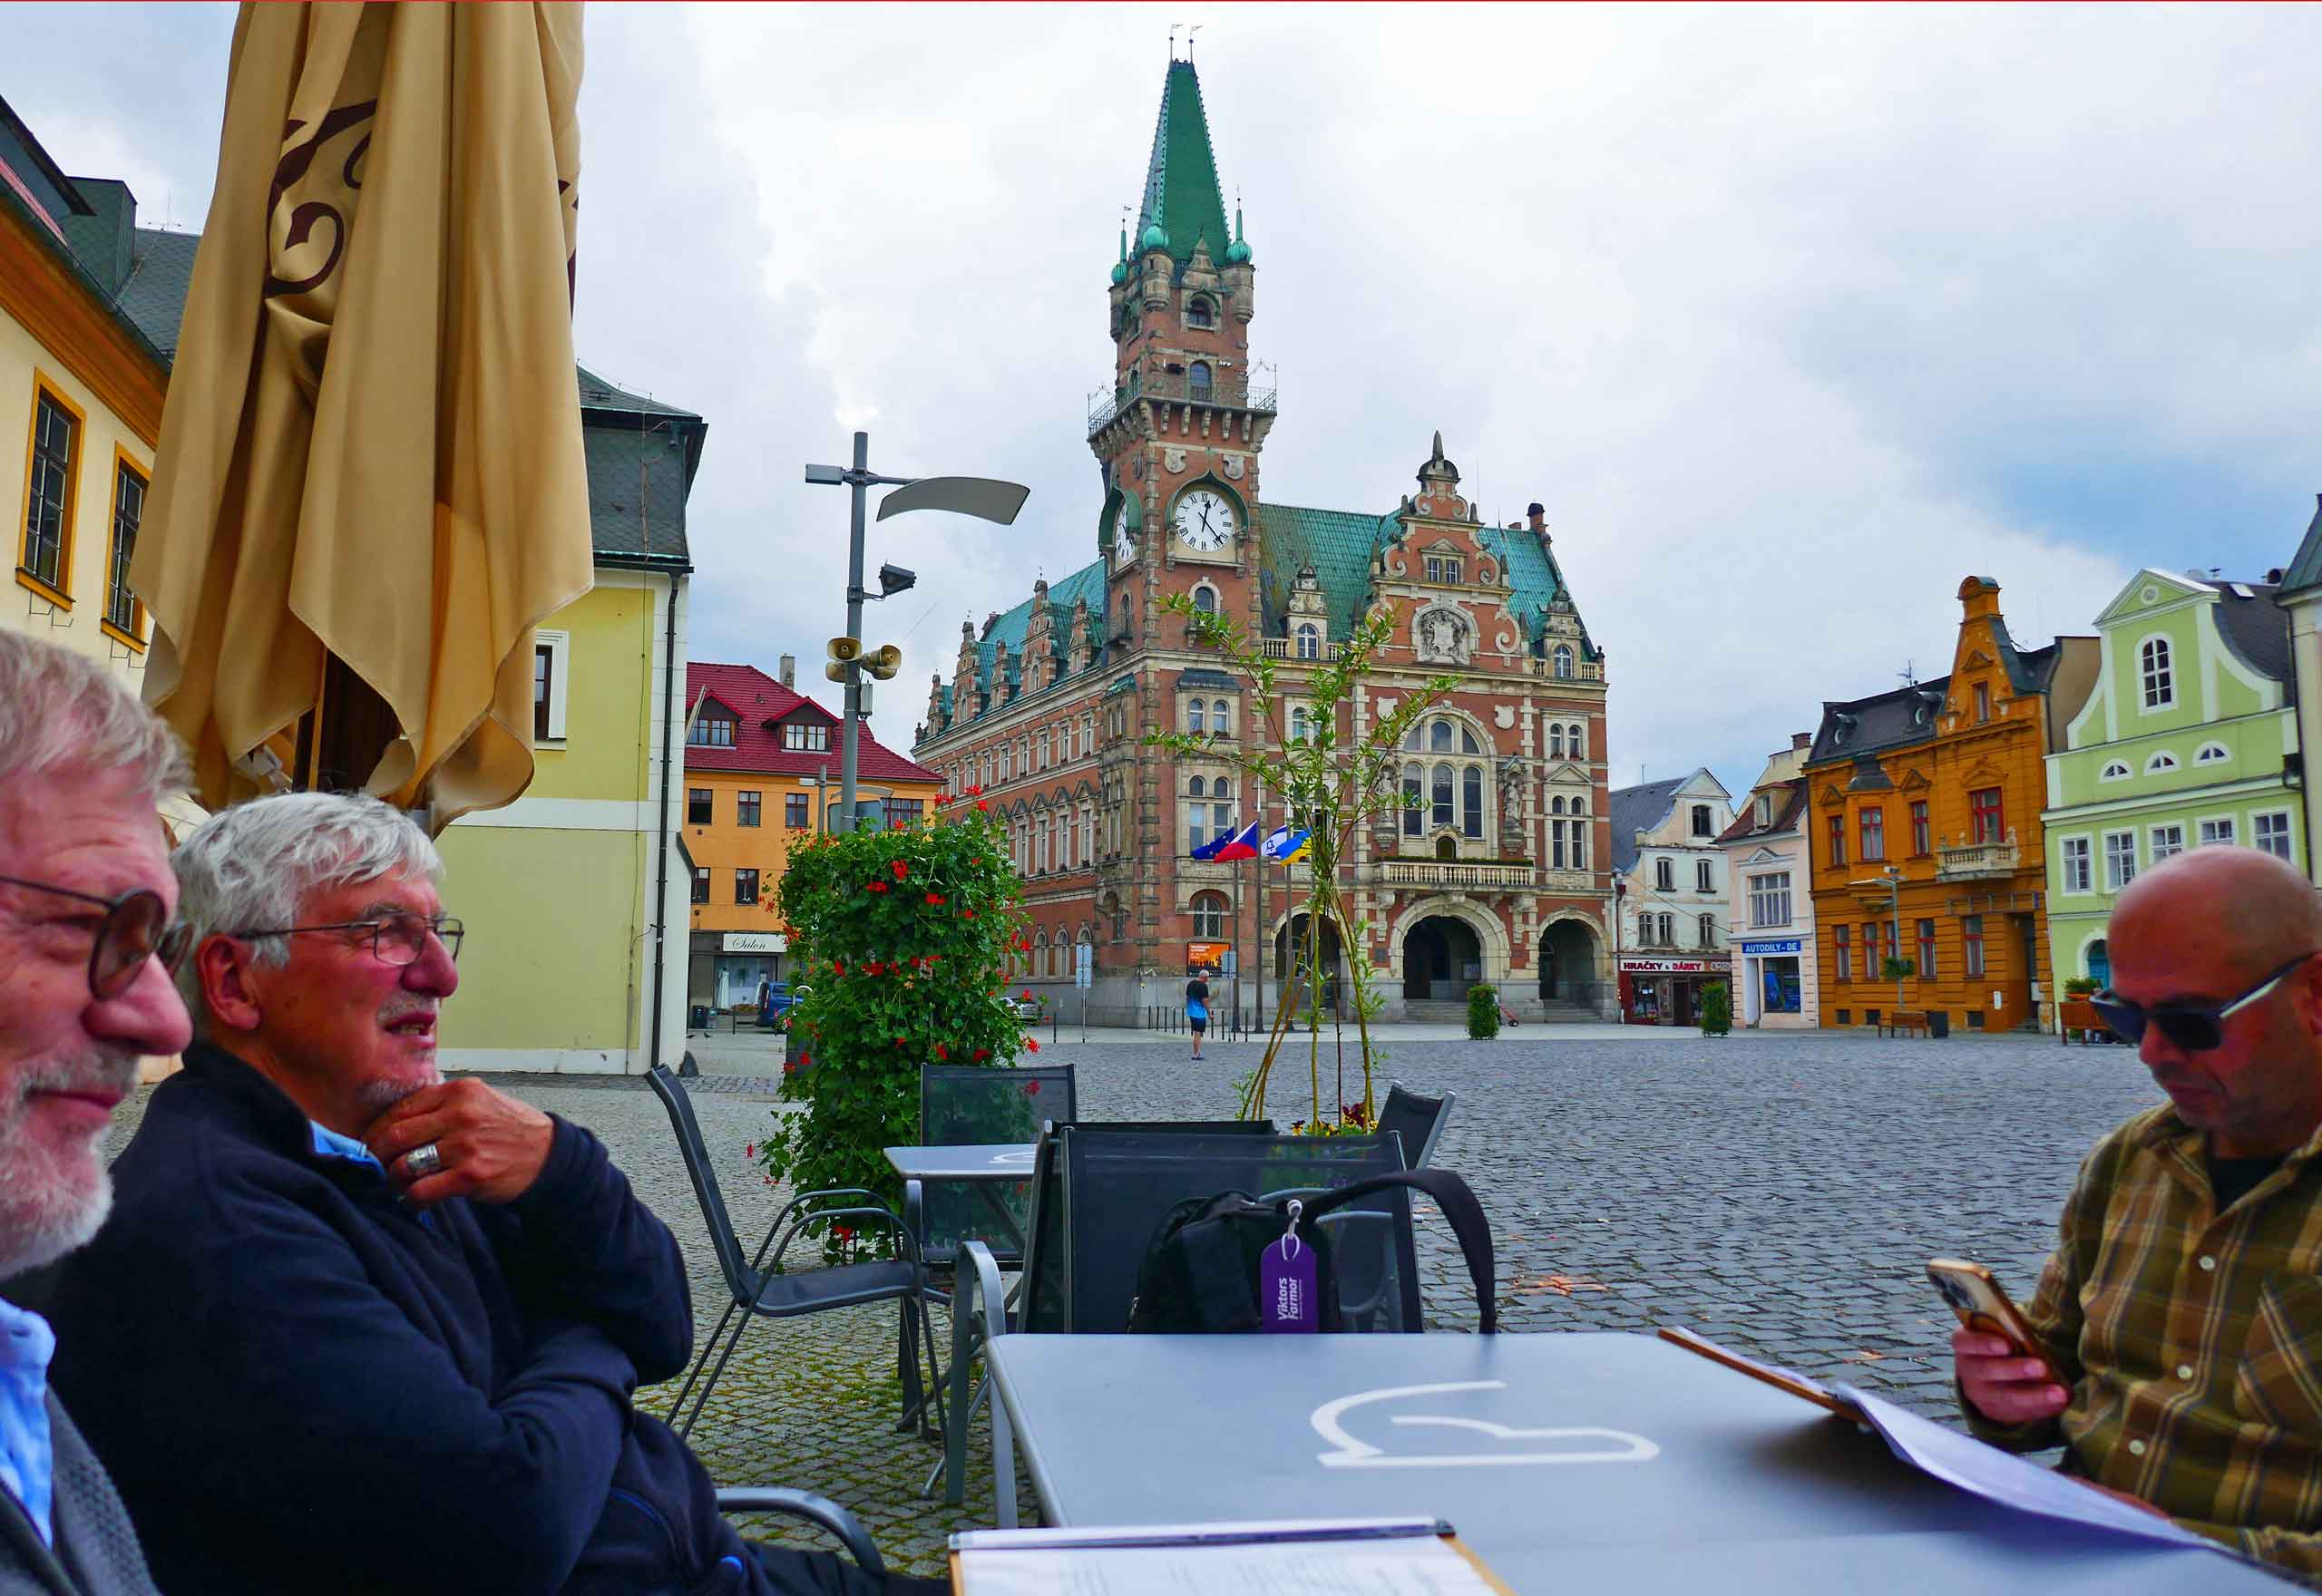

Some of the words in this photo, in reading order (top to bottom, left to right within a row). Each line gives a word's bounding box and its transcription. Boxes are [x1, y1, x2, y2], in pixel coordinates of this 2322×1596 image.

[733, 937, 766, 949] Salon
[1624, 961, 1663, 970] HRAČKY
[1672, 961, 1702, 970] DÁRKY
[1277, 1277, 1289, 1320] Viktors
[1288, 1277, 1299, 1320] Farmor
